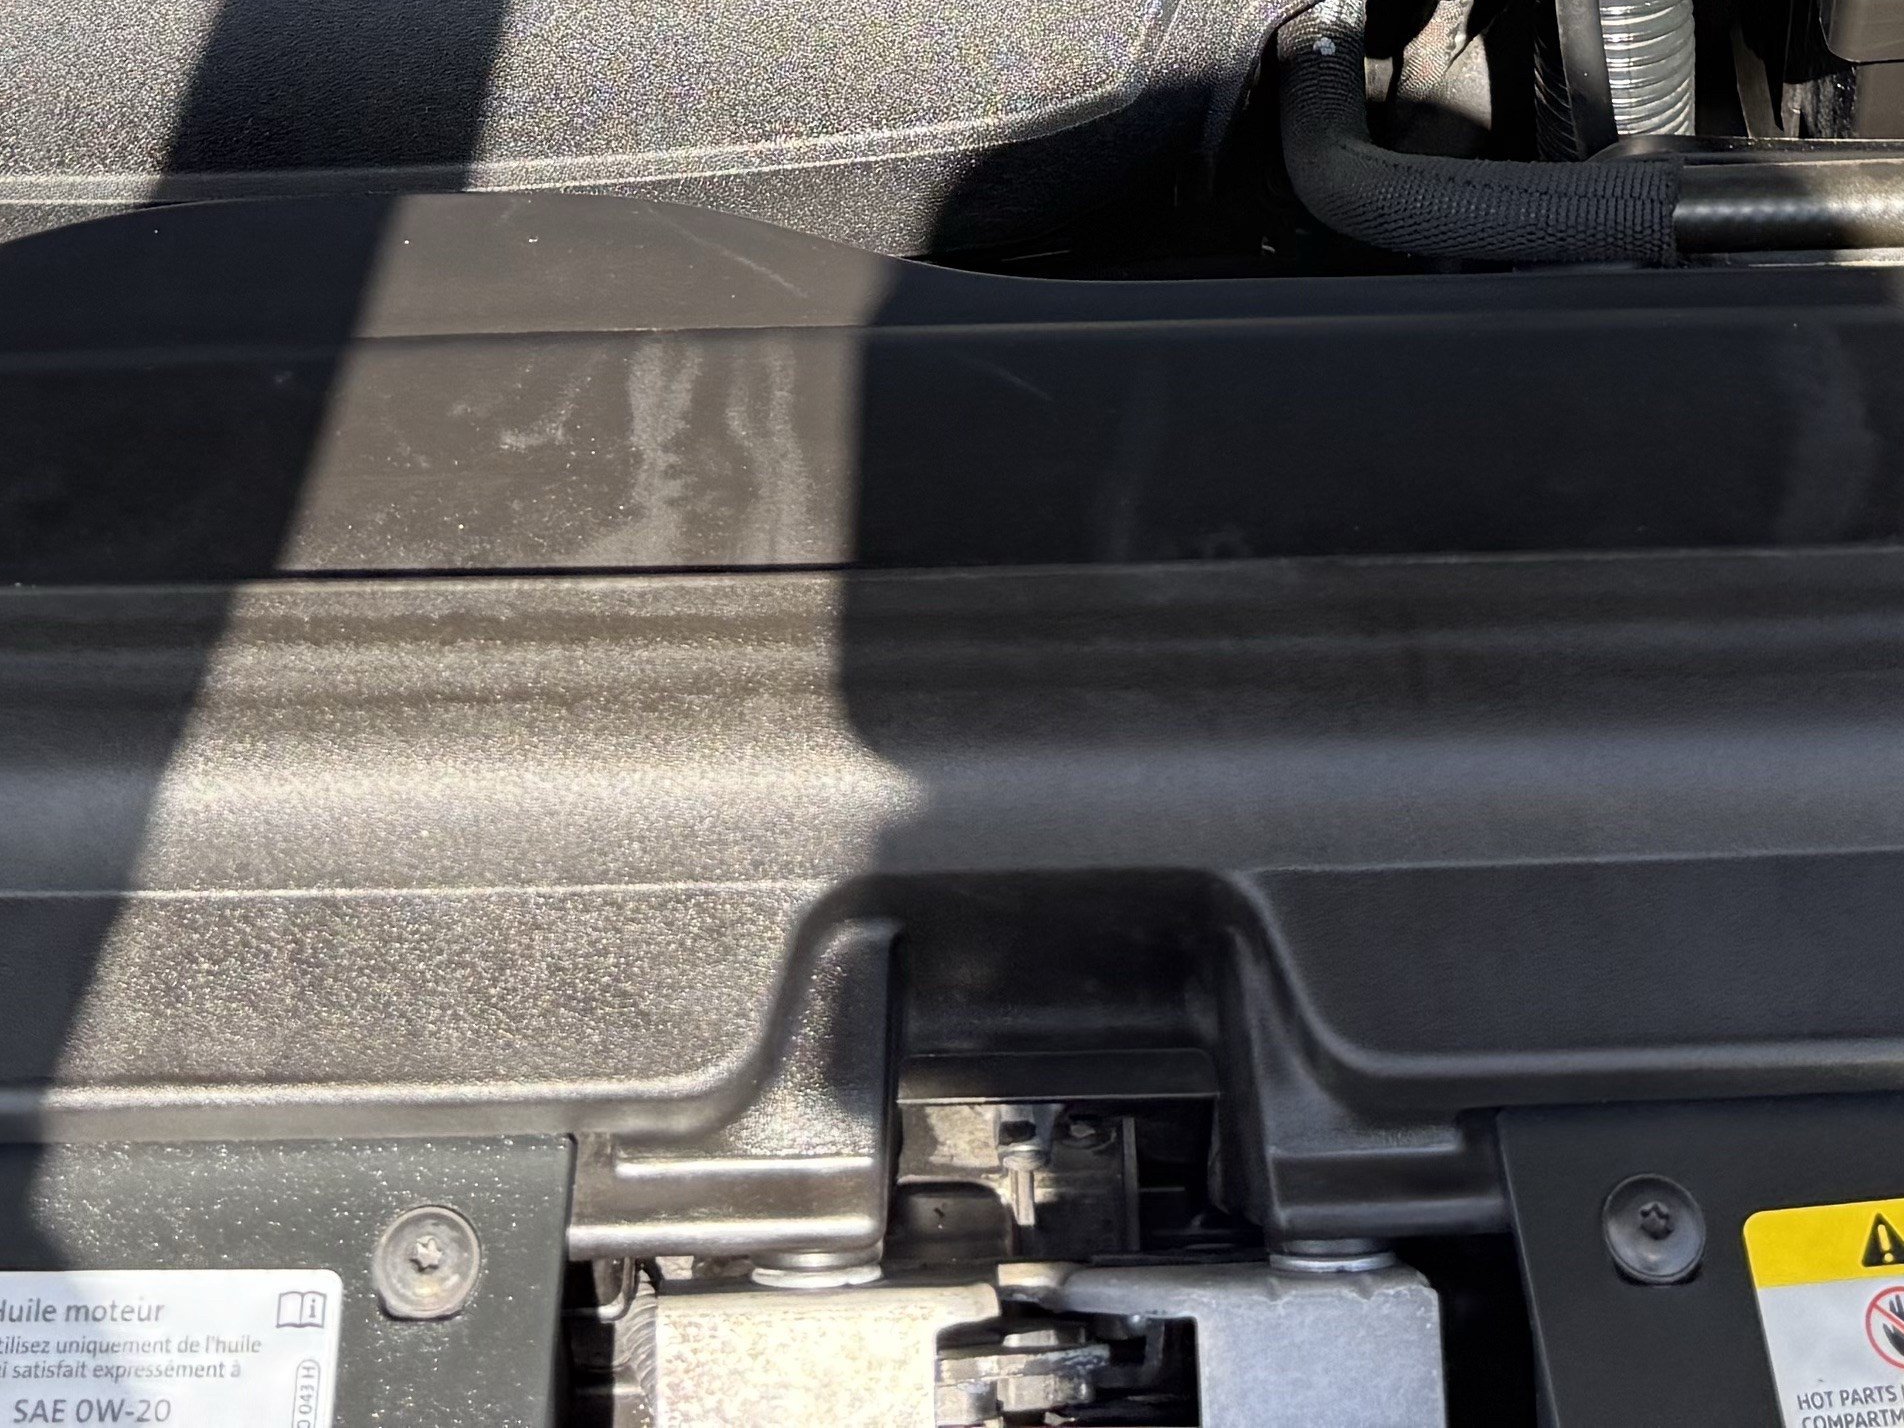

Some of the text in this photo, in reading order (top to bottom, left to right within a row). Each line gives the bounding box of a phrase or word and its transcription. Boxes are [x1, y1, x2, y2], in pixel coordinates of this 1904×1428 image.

[64, 1301, 165, 1324] moteur
[55, 1335, 173, 1359] uniquement
[176, 1334, 202, 1354] de
[204, 1333, 262, 1354] l'huile
[11, 1359, 90, 1380] satisfait
[92, 1358, 226, 1384] expressément
[230, 1358, 243, 1379] à
[1797, 1390, 1834, 1411] HOT
[1839, 1385, 1897, 1407] PARTS
[13, 1399, 66, 1424] SAE
[75, 1399, 172, 1425] 0W-20
